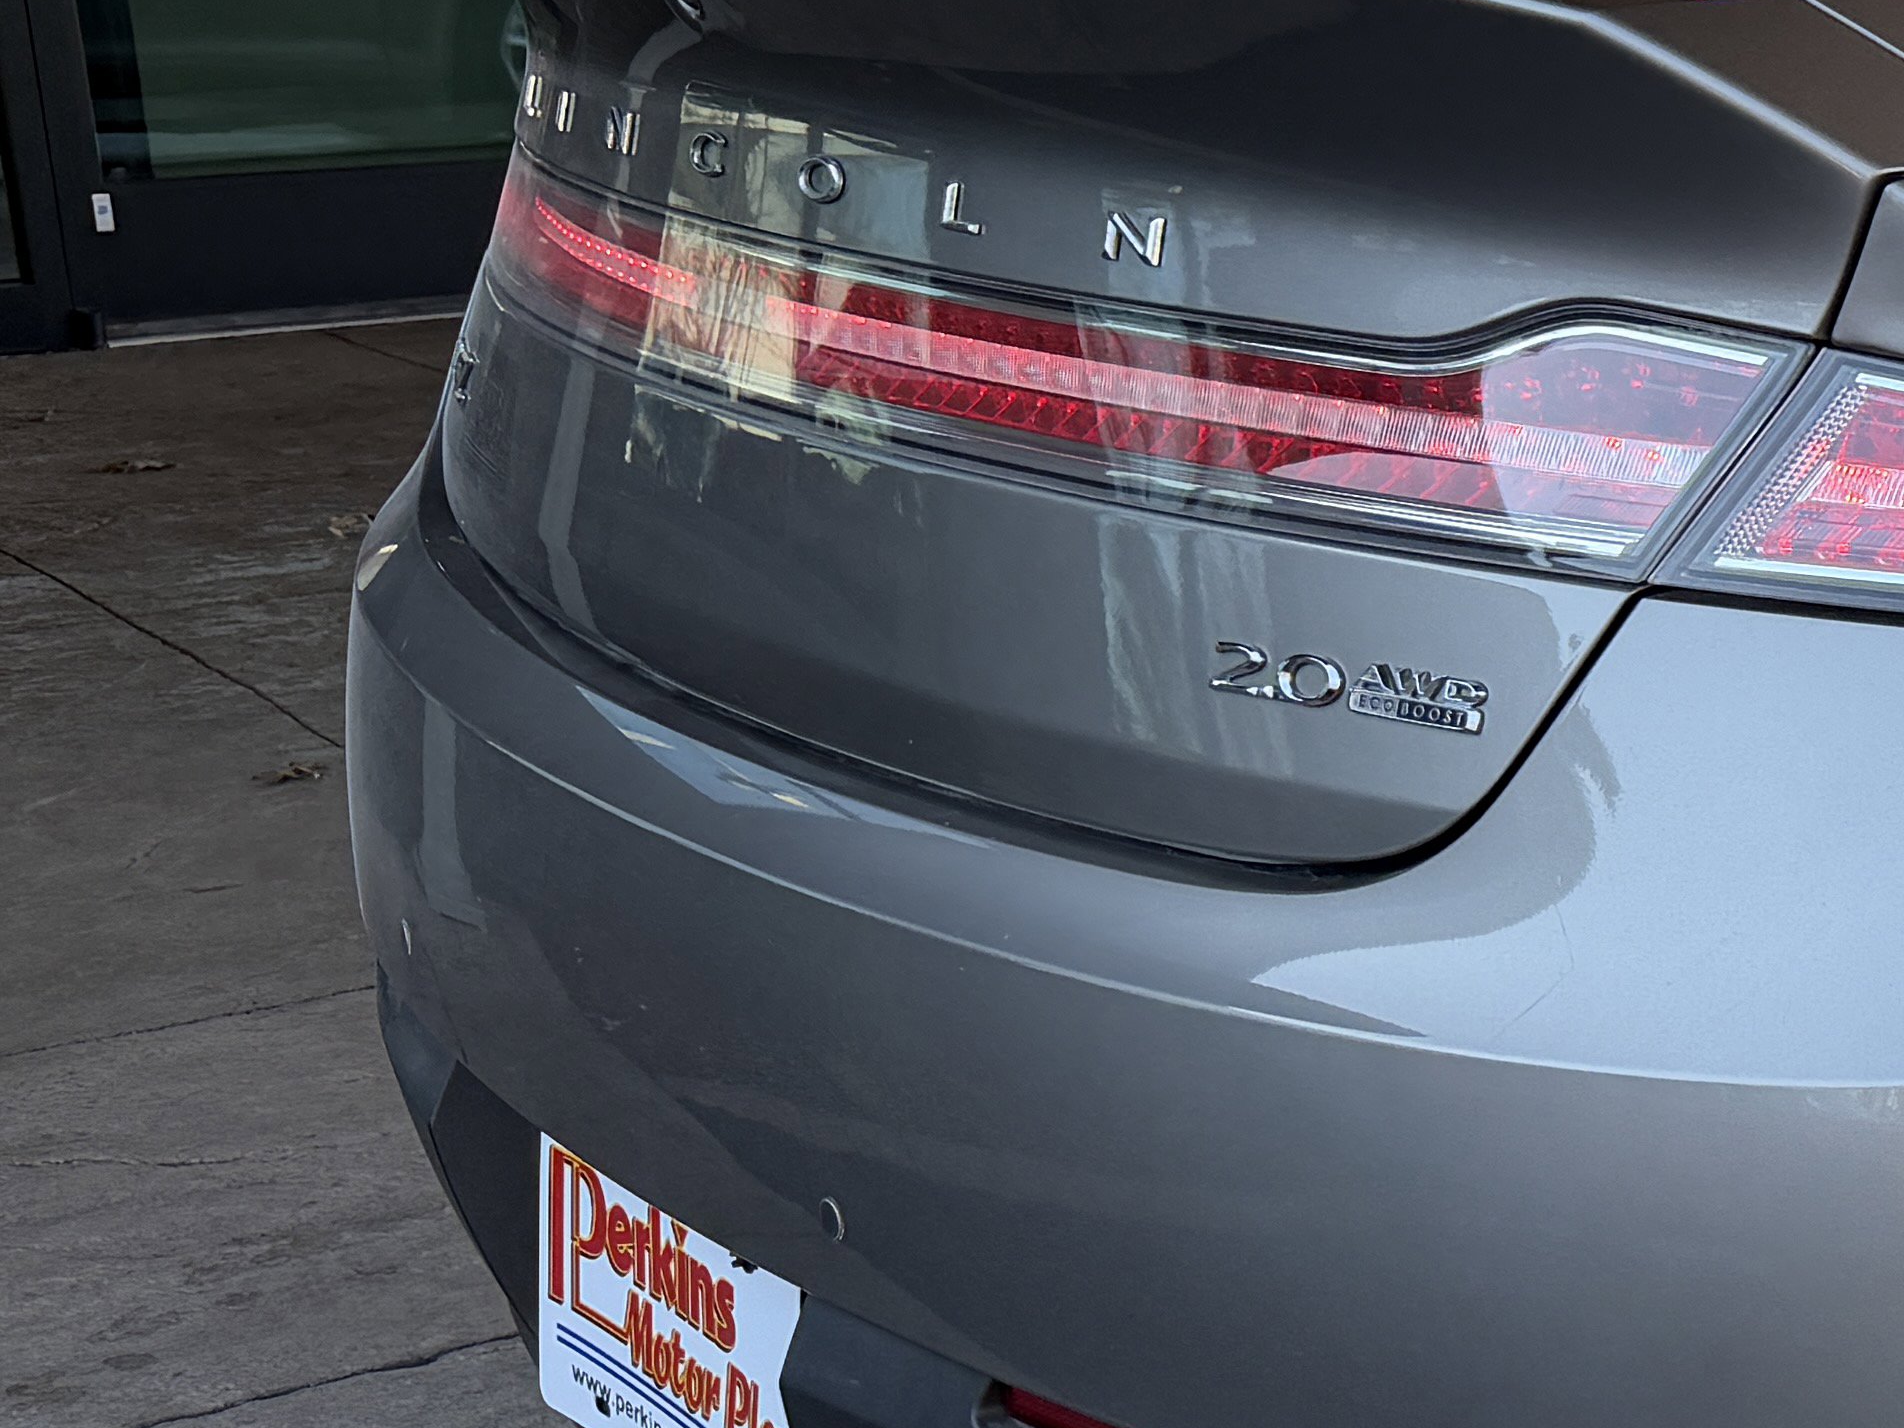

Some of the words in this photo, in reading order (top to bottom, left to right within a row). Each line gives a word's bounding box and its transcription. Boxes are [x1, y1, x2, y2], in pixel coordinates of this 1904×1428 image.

[521, 73, 1169, 268] LINCOLN
[1208, 640, 1347, 708] 2.0
[1349, 662, 1489, 709] AWD
[1357, 693, 1469, 729] ECOBOOST
[548, 1143, 736, 1353] Perkins
[626, 1288, 722, 1422] Motor
